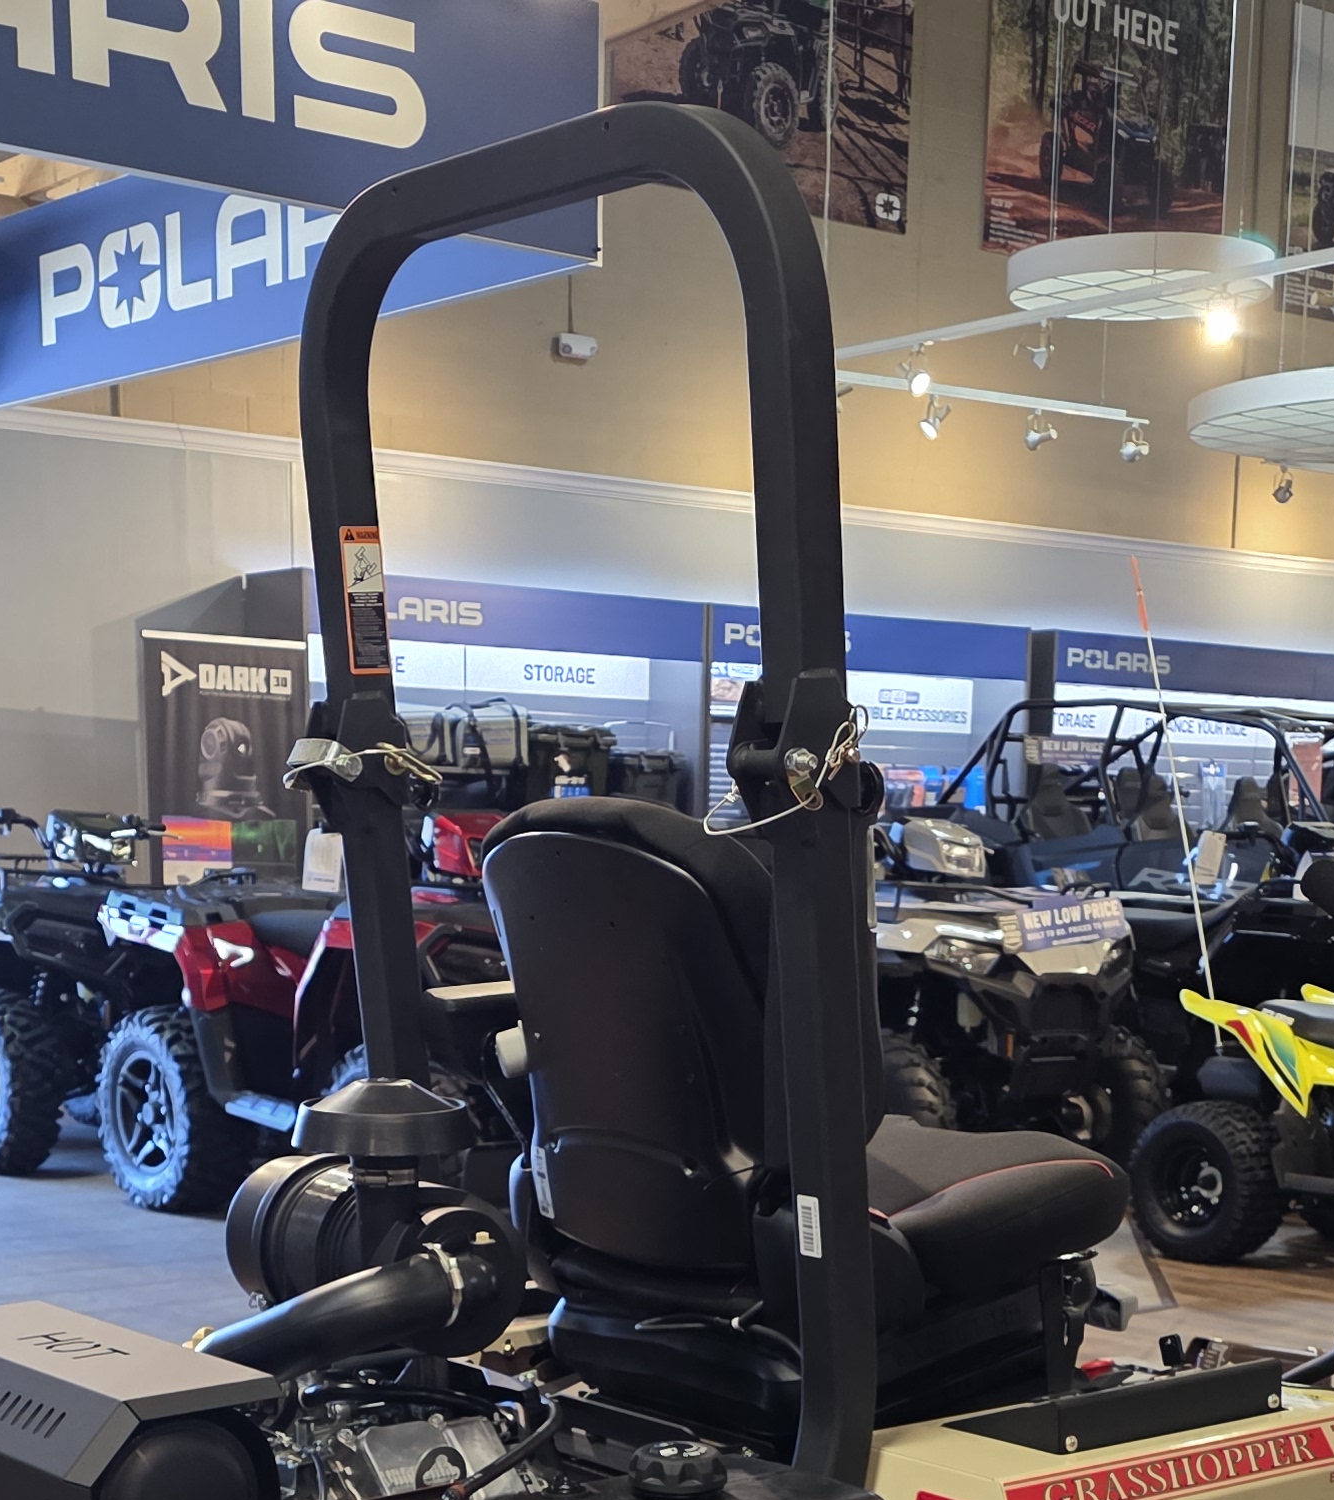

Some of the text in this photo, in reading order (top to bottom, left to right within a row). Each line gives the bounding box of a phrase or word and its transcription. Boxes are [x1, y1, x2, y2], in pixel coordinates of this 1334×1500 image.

[1113, 4, 1180, 56] HERE
[198, 663, 267, 693] DARK
[523, 664, 596, 685] STORAGE
[895, 707, 968, 724] ACCESSORIES
[1022, 901, 1120, 930] NEW LOW PRICE
[16, 1331, 131, 1360] HOT
